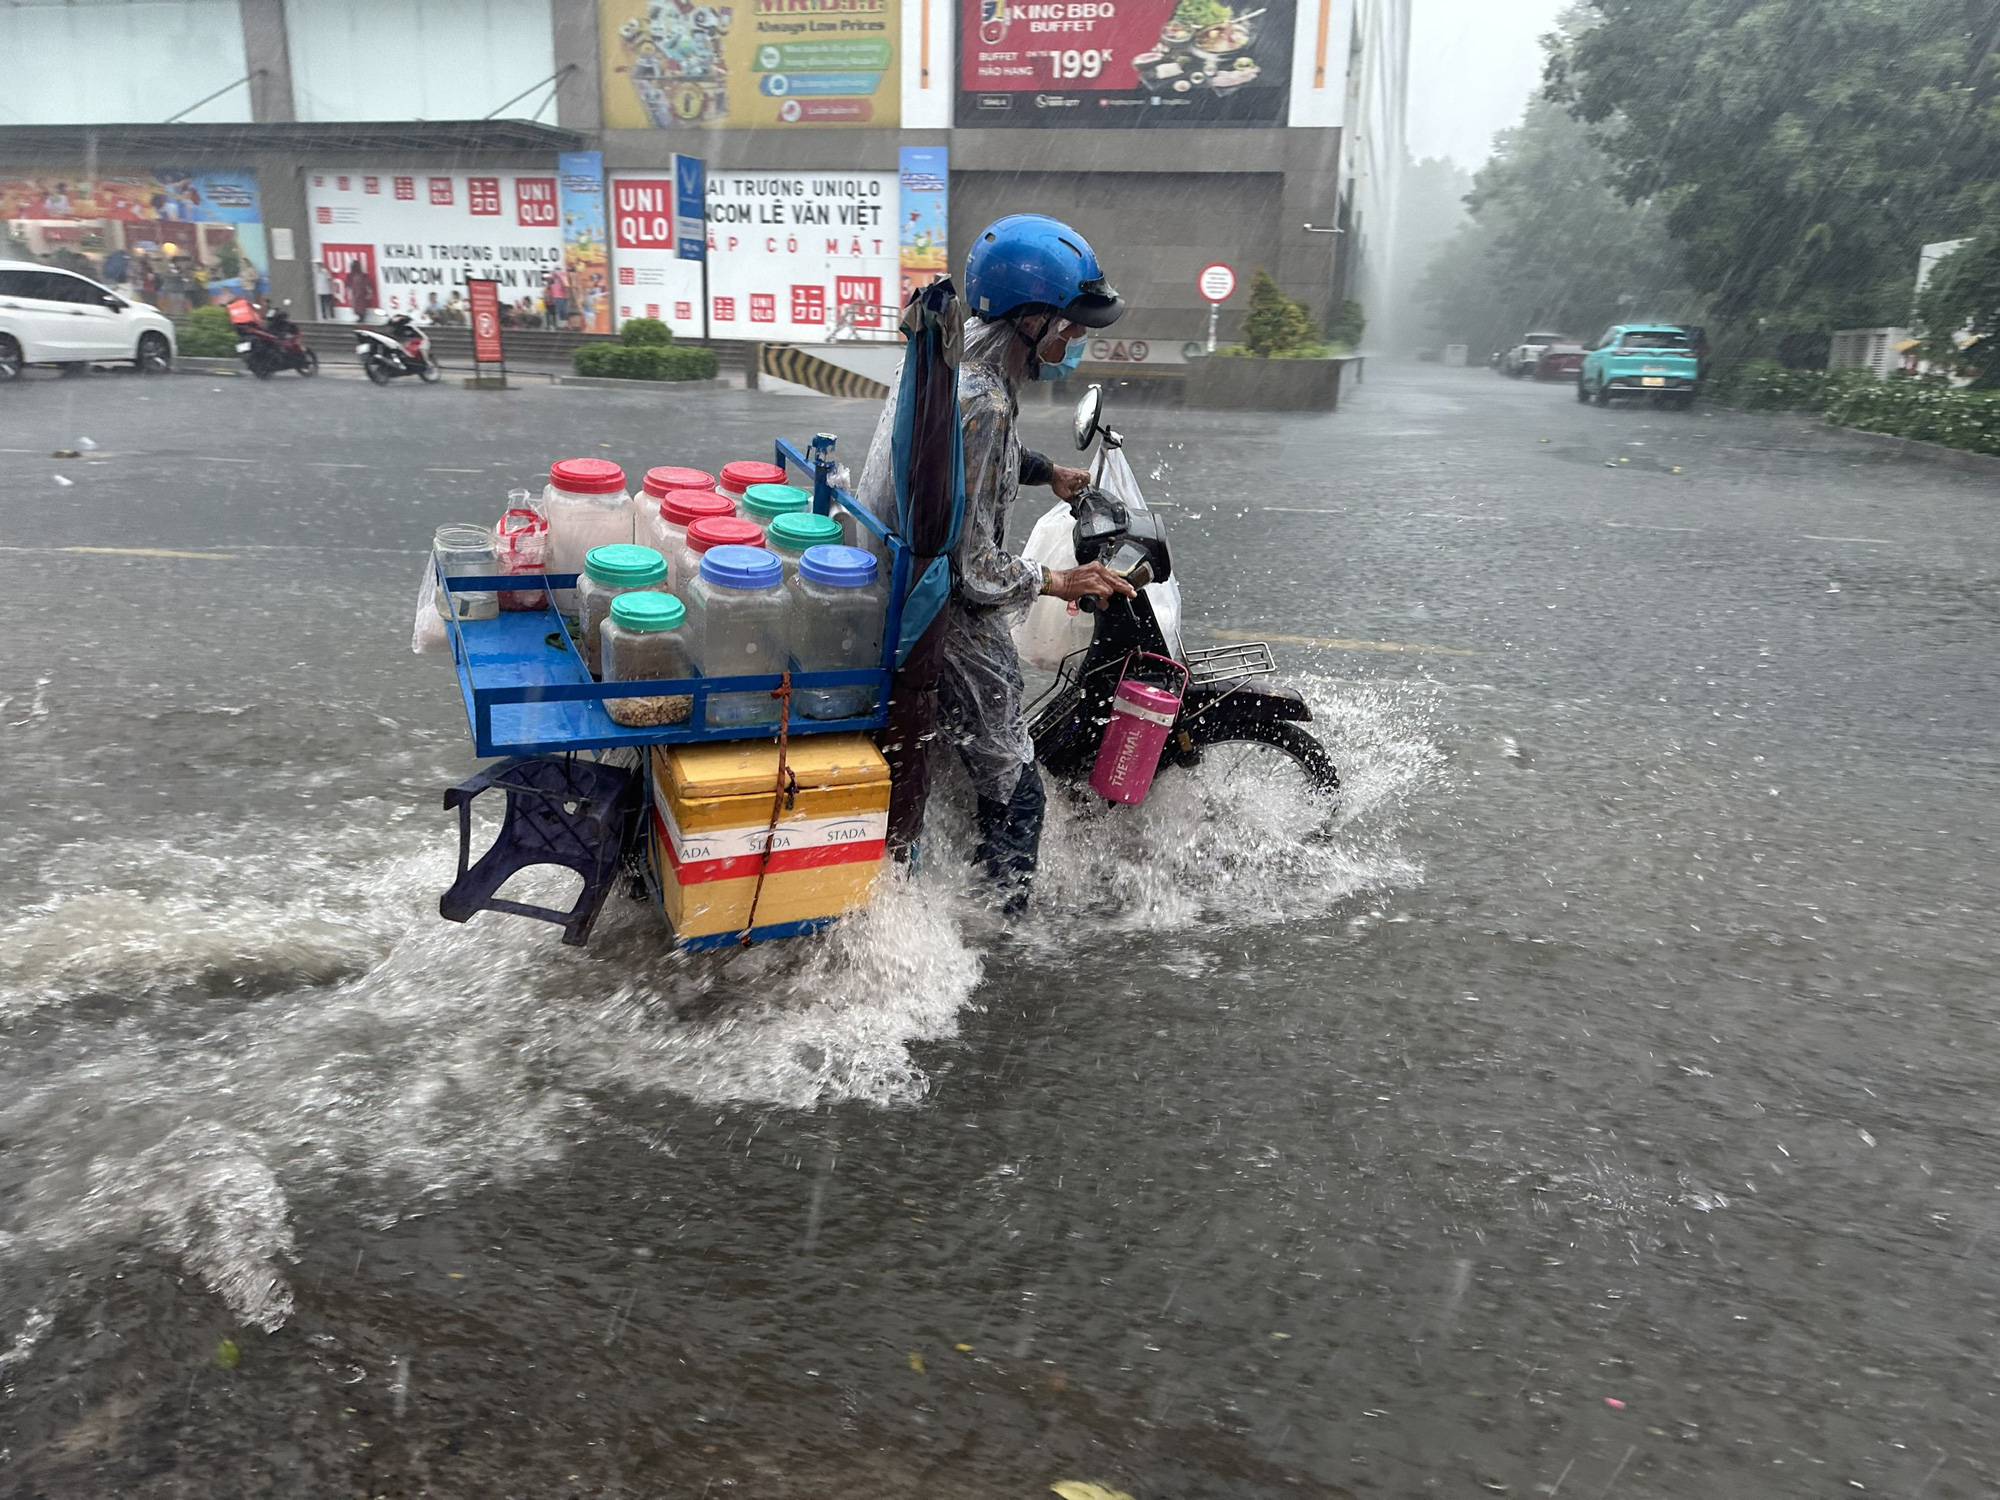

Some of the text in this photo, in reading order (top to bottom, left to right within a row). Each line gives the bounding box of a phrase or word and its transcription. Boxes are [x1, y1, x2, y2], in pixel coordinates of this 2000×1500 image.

[1012, 2, 1116, 19] KING BBQ
[840, 19, 886, 32] Prices
[1029, 20, 1096, 33] BUFFET
[518, 183, 551, 201] UNI
[618, 188, 664, 212] UNI
[812, 180, 881, 200] UNIQLO
[521, 204, 555, 224] QLO
[759, 198, 785, 224] LÊ
[791, 200, 830, 226] VĂN
[837, 199, 882, 232] VIỆT
[620, 217, 669, 245] QLO
[383, 243, 423, 260] KHAI
[499, 246, 560, 265] UNIQLO
[380, 265, 444, 286] VINCOM
[840, 281, 874, 301] UNI
[1111, 730, 1141, 786] THERMAL
[826, 827, 867, 842] STADA
